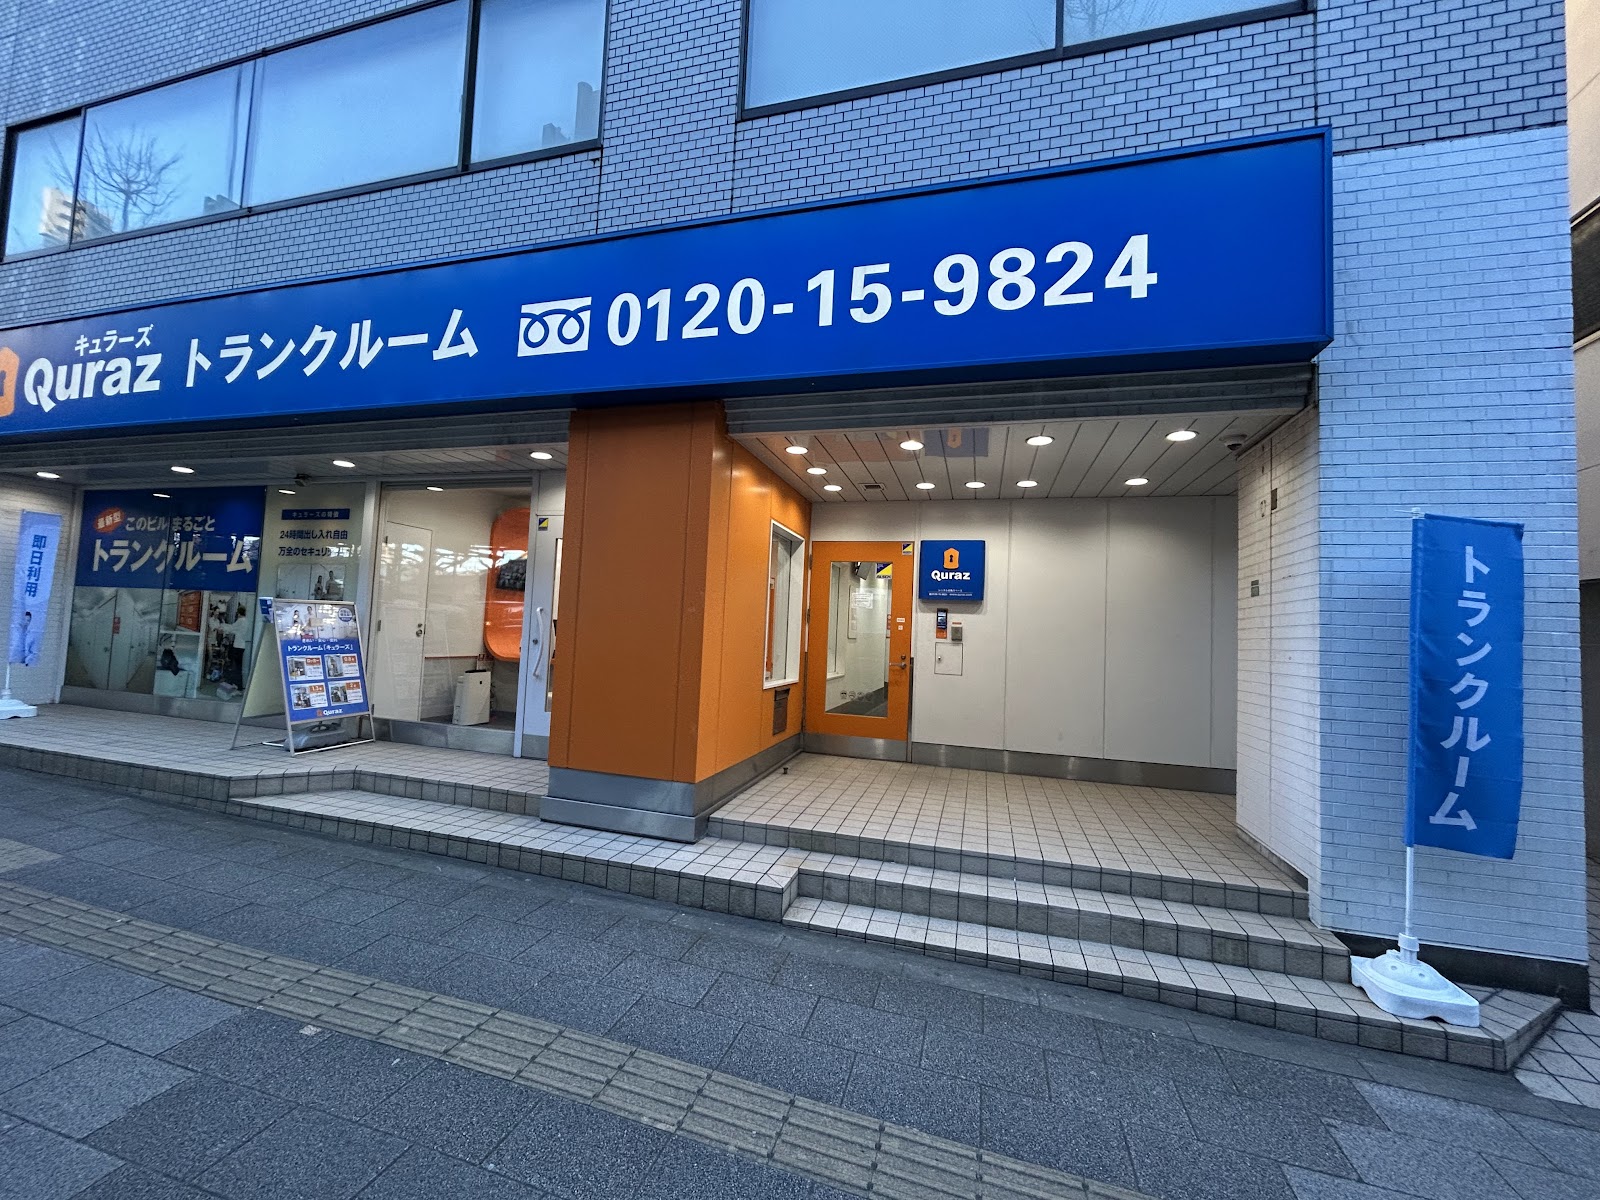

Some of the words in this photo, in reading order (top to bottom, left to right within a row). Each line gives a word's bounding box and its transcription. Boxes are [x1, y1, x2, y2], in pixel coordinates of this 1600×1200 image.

[606, 233, 1158, 347] 0120-15-9824
[74, 323, 154, 357] キュラーズ
[186, 308, 479, 388] トランクルーム
[23, 352, 163, 413] Quraz
[92, 538, 253, 574] トランクルーム
[277, 545, 342, 557] 万全のセキュリ
[279, 529, 348, 540] 24時間出し入れ自由
[24, 534, 47, 598] 即日利用
[931, 569, 971, 581] Quraz
[1428, 545, 1492, 831] トランクルーム
